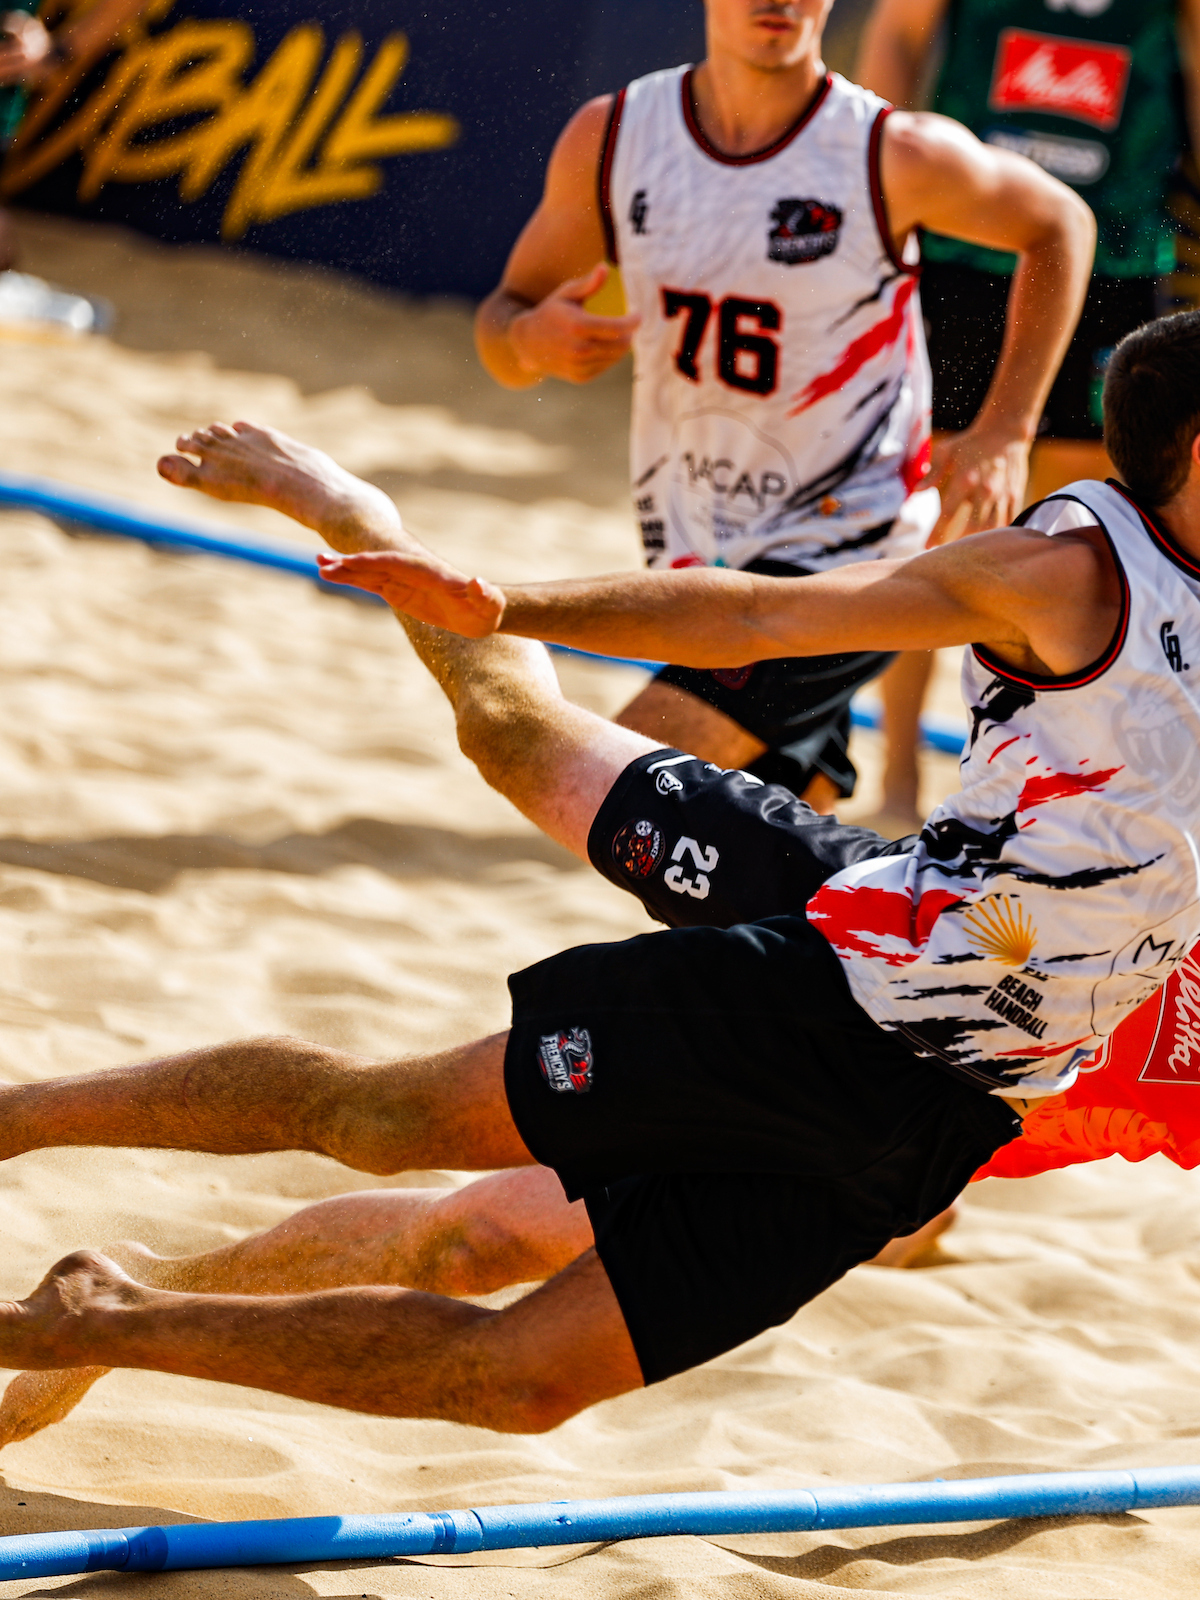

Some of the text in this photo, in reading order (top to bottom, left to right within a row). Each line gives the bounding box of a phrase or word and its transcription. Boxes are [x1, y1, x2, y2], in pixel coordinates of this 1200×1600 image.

[661, 285, 784, 397] 76
[664, 836, 720, 900] 23
[983, 988, 1049, 1040] HANDBALL
[997, 974, 1044, 1013] BEACH
[541, 1034, 572, 1091] FRENCHYS
